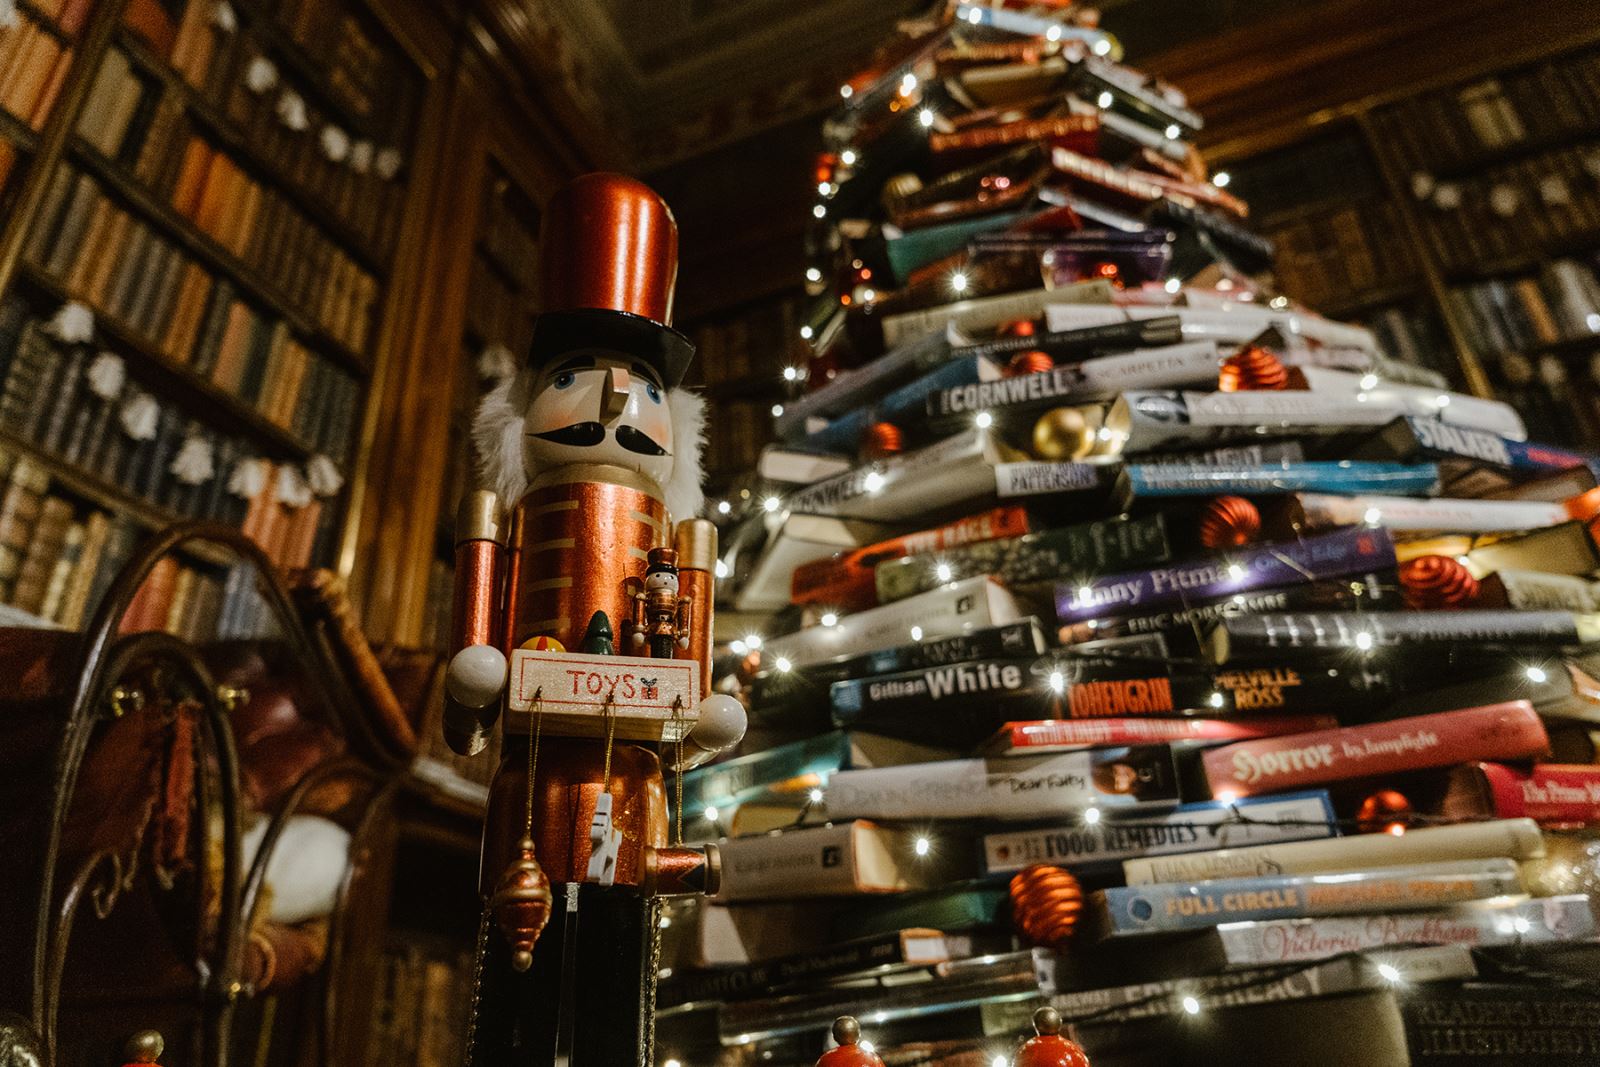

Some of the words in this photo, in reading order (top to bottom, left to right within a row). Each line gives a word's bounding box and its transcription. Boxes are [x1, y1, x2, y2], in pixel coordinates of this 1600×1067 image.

[950, 371, 1070, 412] CORNWELL
[1411, 415, 1512, 465] STALKER
[1010, 470, 1093, 492] PATTERSON
[1068, 580, 1143, 611] Jnny
[1151, 566, 1240, 594] Pitma
[566, 669, 637, 700] TOYS
[869, 678, 928, 701] Gillian
[926, 663, 1022, 699] White
[1215, 668, 1302, 689] MELVILLE
[1068, 677, 1174, 718] LOHENGRIN
[1234, 686, 1284, 710] ROSS
[1232, 744, 1334, 782] Horror
[1009, 775, 1047, 794] Dear
[1045, 831, 1095, 857] FOOD
[1104, 822, 1198, 851] REMEDIES
[1167, 893, 1219, 916] FULL
[1223, 888, 1298, 912] CIRCLE
[1262, 921, 1361, 961] Victoria
[1366, 914, 1480, 946] Beckham
